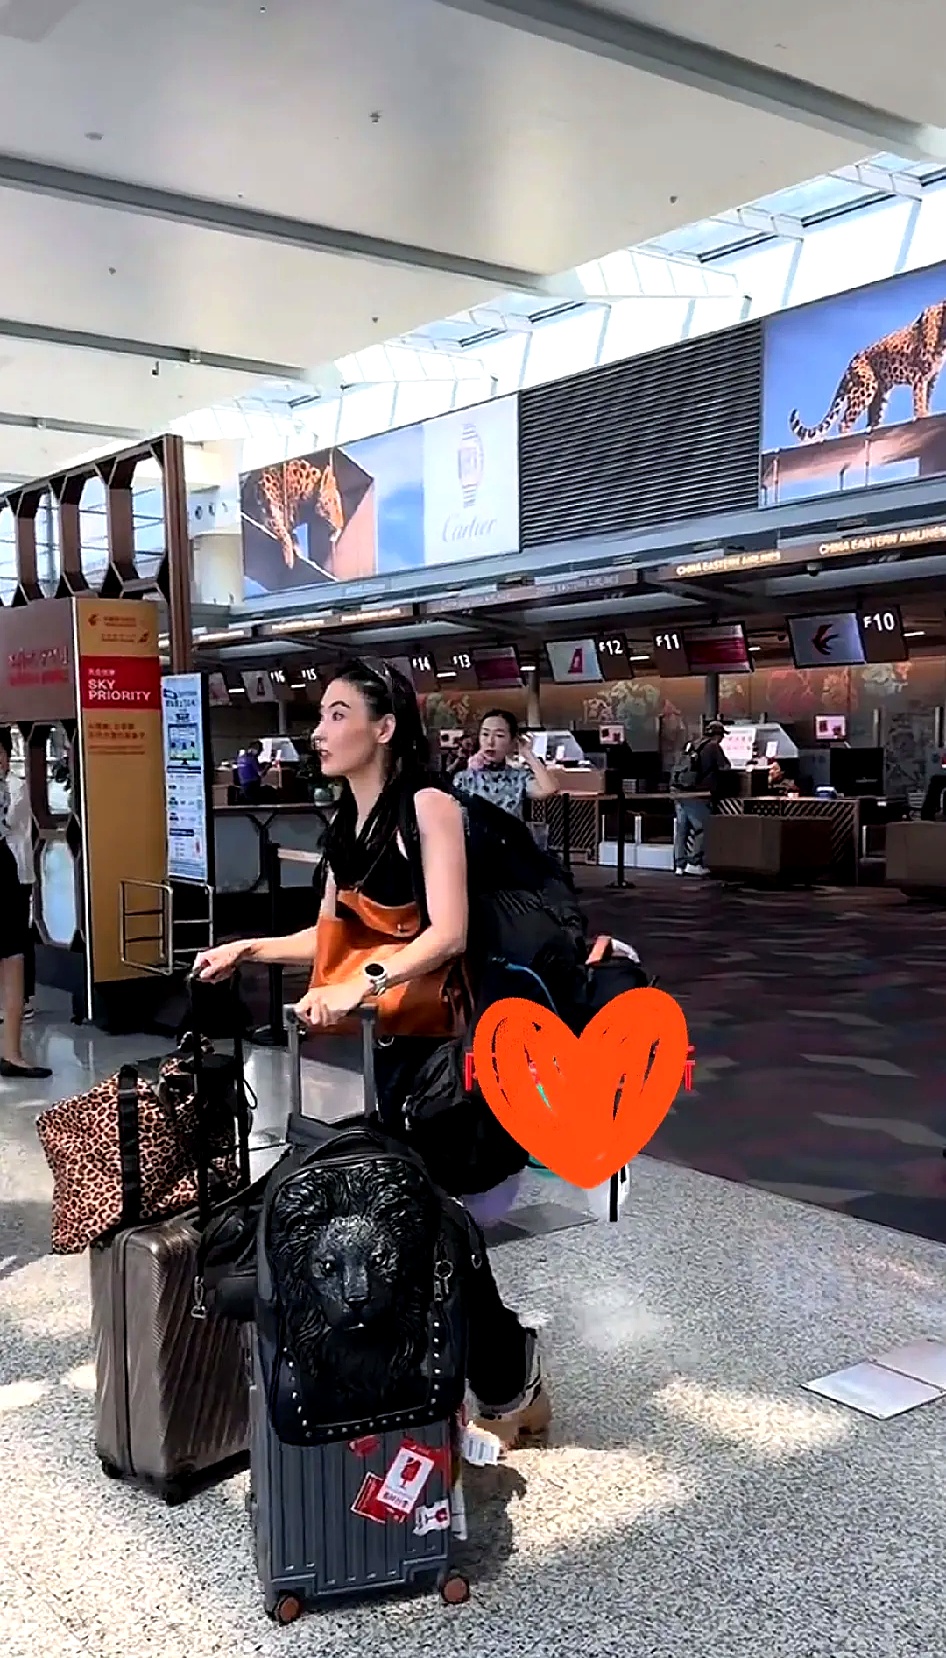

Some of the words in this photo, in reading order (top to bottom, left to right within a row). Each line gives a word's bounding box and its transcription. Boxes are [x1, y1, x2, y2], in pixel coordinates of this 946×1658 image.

[442, 513, 498, 542] Cartier
[850, 533, 898, 550] EASTERN
[864, 612, 895, 632] F10
[599, 639, 624, 656] F12
[656, 633, 680, 650] F11
[88, 678, 116, 690] SKY
[88, 690, 152, 701] PRIORITY
